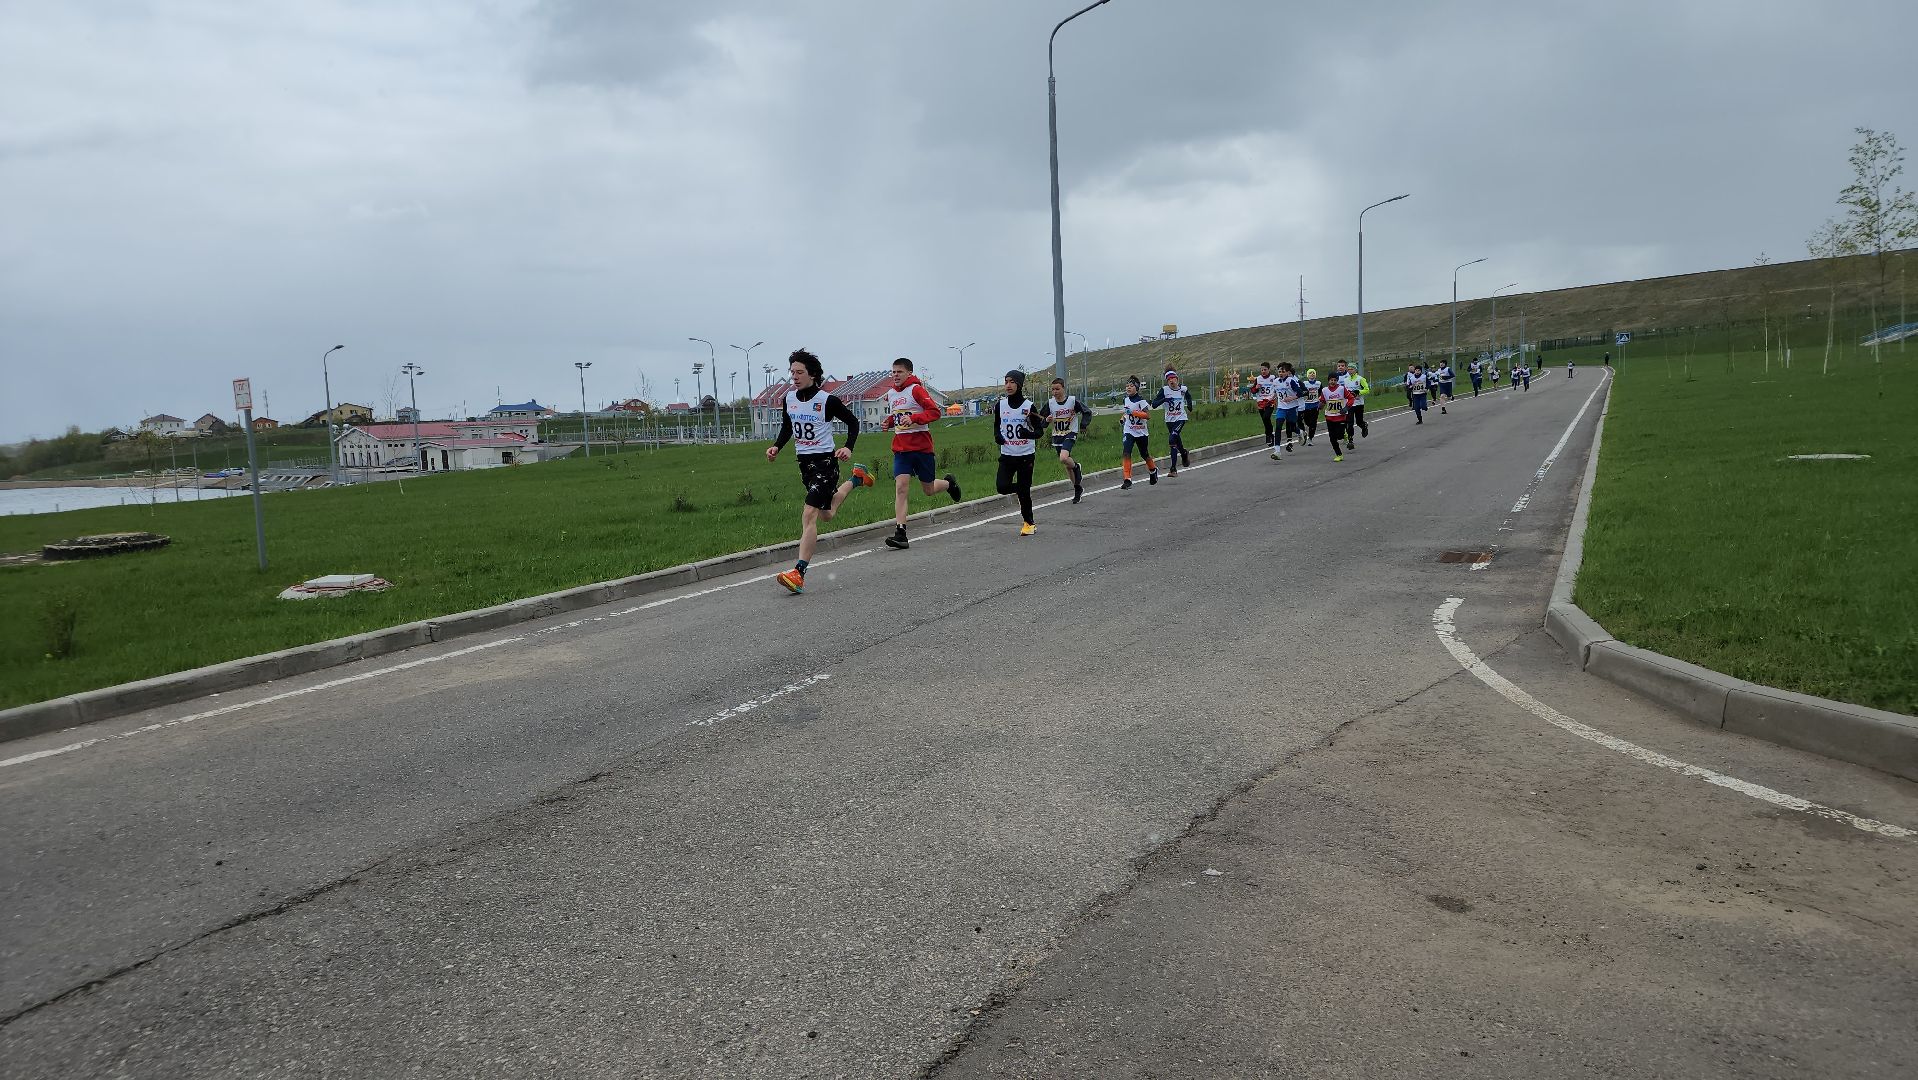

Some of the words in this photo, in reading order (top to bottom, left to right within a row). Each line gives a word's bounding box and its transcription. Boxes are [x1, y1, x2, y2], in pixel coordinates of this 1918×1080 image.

[1168, 400, 1182, 412] 84
[794, 421, 816, 440] 98
[1054, 420, 1072, 432] 102
